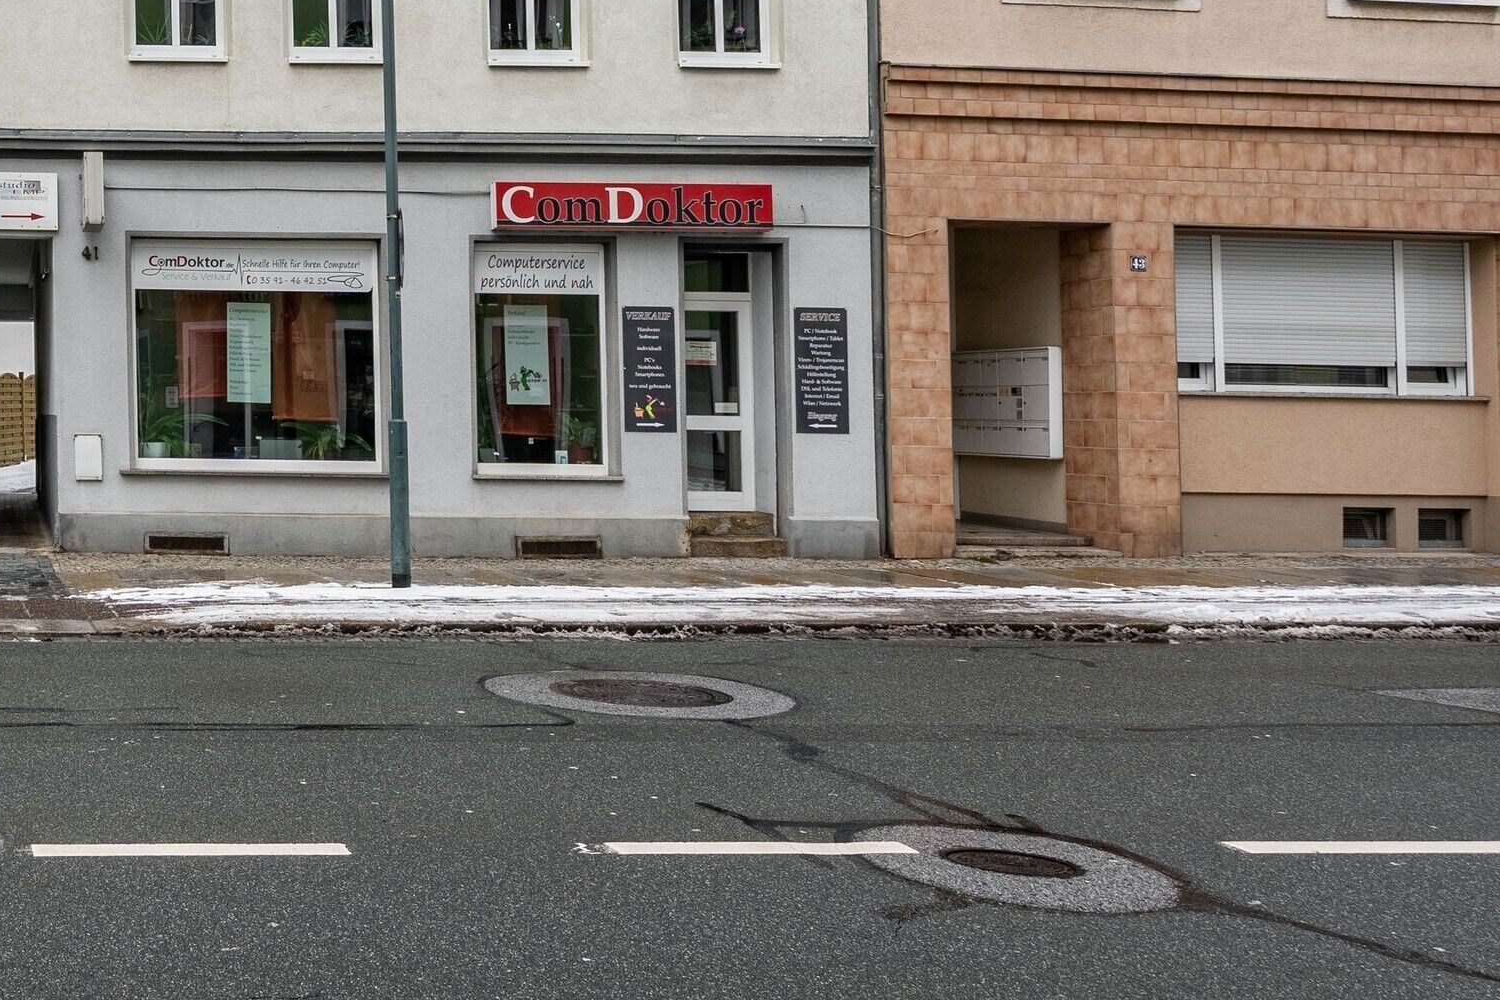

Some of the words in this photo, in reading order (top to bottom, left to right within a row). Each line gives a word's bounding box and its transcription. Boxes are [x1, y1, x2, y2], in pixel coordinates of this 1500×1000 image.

[501, 185, 764, 226] ComDoktor
[81, 246, 99, 261] 41
[241, 258, 269, 269] Schnelle
[272, 258, 287, 269] Hilfe
[290, 258, 301, 269] für
[303, 259, 322, 269] Ihren
[323, 260, 361, 271] Computer!
[487, 254, 586, 273] Computerservice
[1132, 258, 1145, 269] 43
[161, 271, 190, 280] Service
[191, 272, 198, 280] &
[200, 271, 232, 281] Verkauf
[251, 277, 258, 285] 0
[260, 276, 271, 285] 35
[274, 276, 283, 285] 91
[290, 277, 302, 285] 46
[304, 277, 315, 285] 42
[317, 277, 327, 285] 51
[480, 273, 540, 291] persönlich
[544, 274, 567, 288] und
[571, 274, 594, 289] nah
[625, 311, 671, 321] VERKAUF
[799, 312, 841, 322] SERVICE
[806, 411, 838, 422] Eingang
